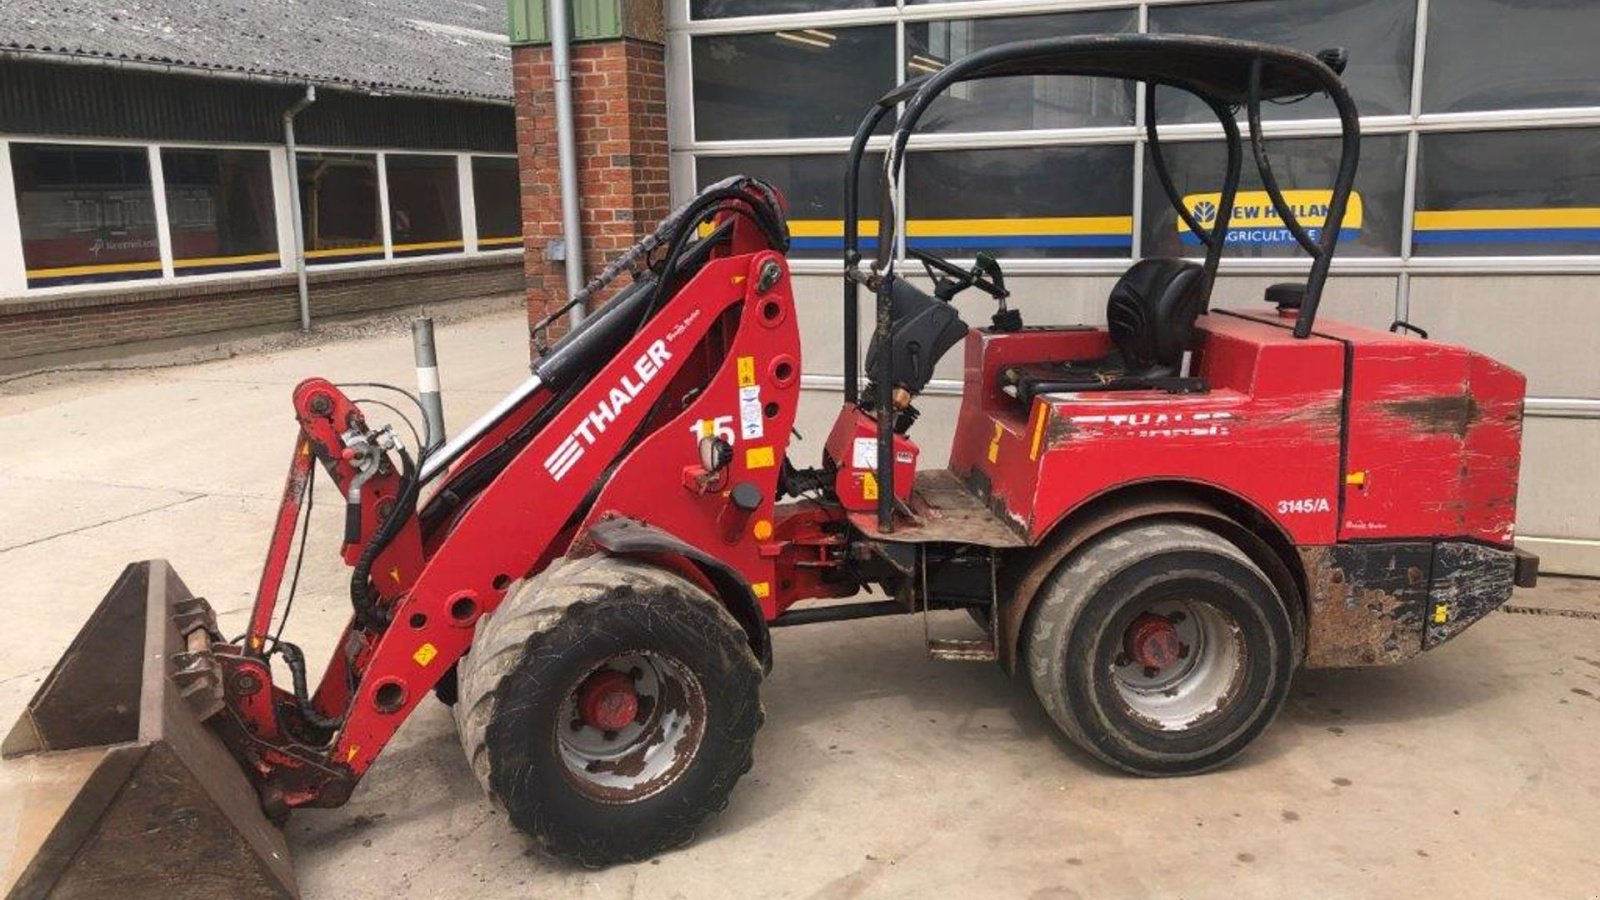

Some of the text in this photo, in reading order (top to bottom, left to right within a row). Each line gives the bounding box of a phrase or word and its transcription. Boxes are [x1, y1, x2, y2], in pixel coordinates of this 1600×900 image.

[1230, 204, 1330, 219] EW HLLAN
[572, 338, 673, 445] THALER
[1277, 497, 1330, 514] 3145/A
